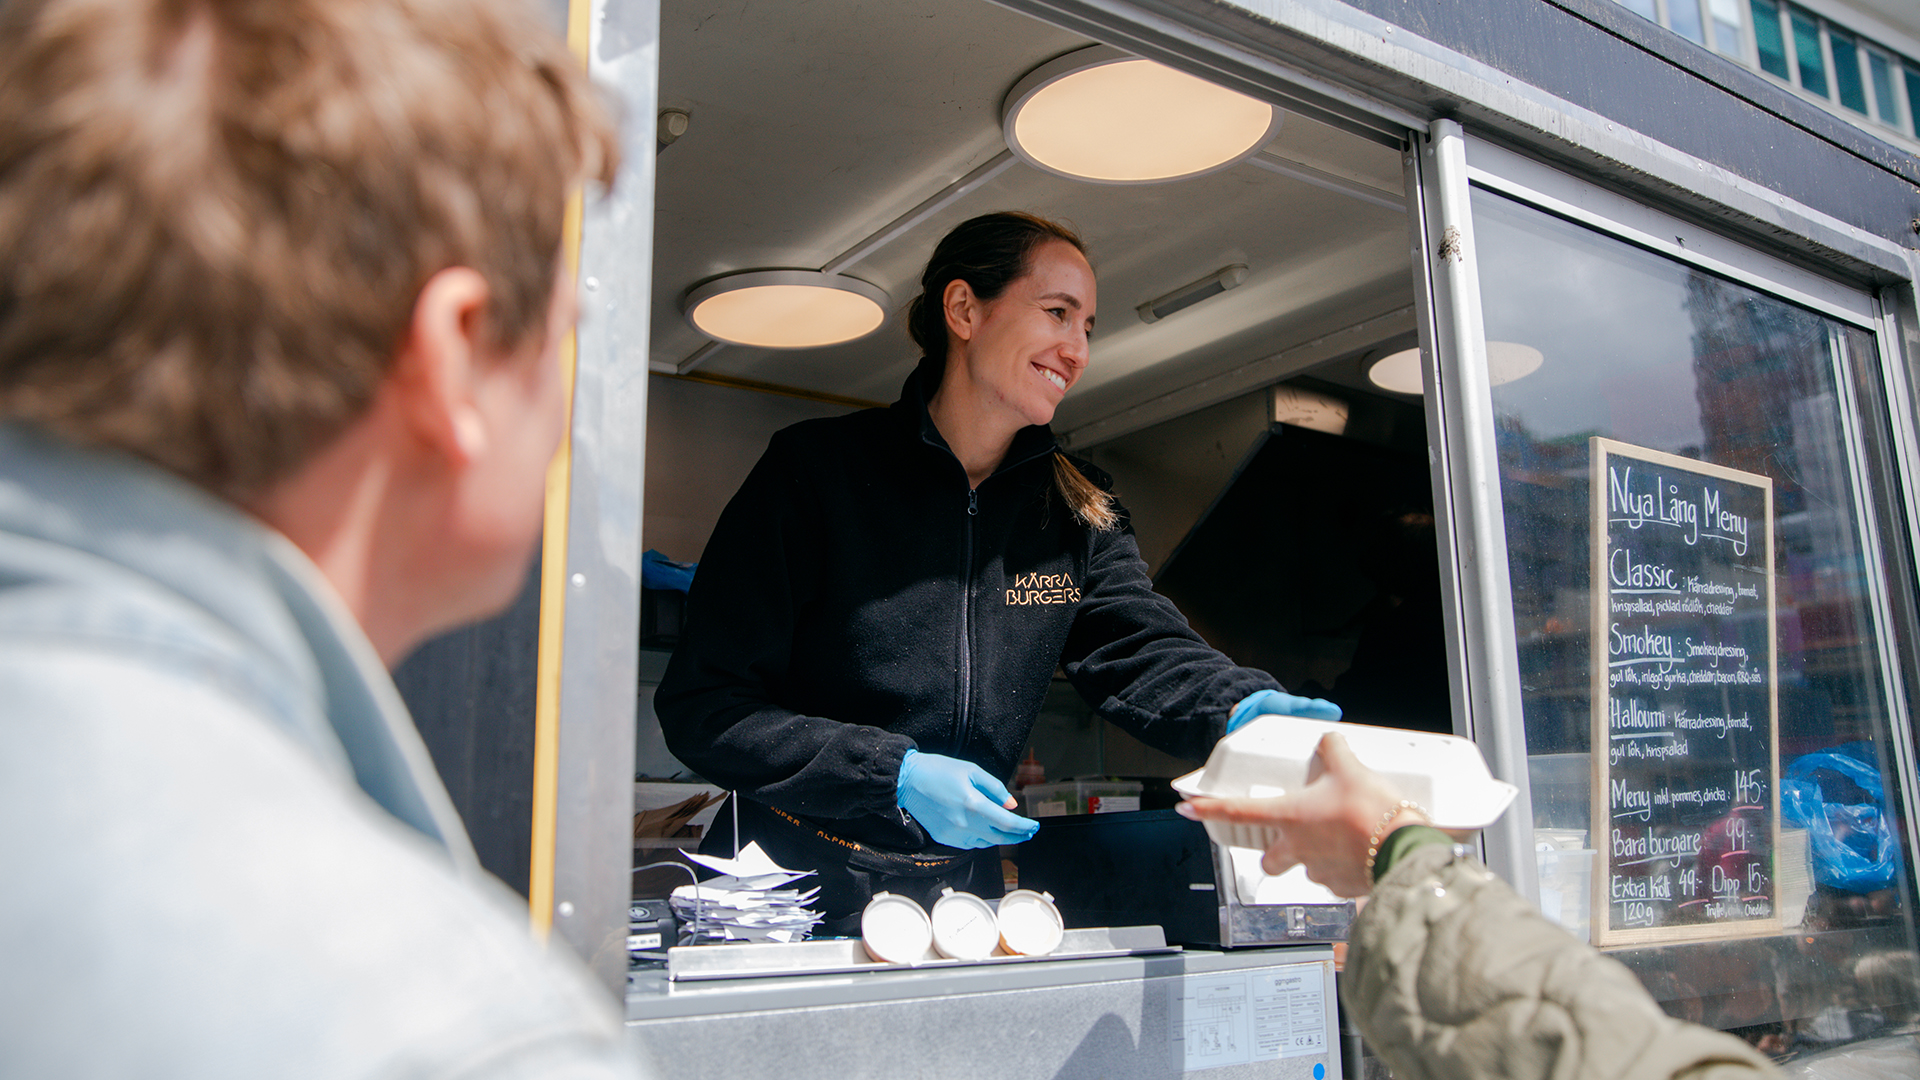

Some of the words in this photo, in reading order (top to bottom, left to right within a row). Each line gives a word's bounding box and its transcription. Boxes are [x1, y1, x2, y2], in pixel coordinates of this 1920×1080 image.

[1610, 466, 1653, 529] Nya
[1658, 476, 1697, 545] Lång
[1704, 486, 1748, 556] Meny
[1015, 572, 1073, 589] KÄRRA
[1005, 587, 1081, 606] BURGERS
[1609, 669, 1624, 688] gul
[1609, 743, 1625, 766] gul
[1611, 778, 1651, 822] Meny
[816, 829, 861, 852] ALPAKA
[1612, 828, 1647, 858] Bara
[1611, 875, 1646, 898] Extra
[1712, 865, 1740, 903] Dipp
